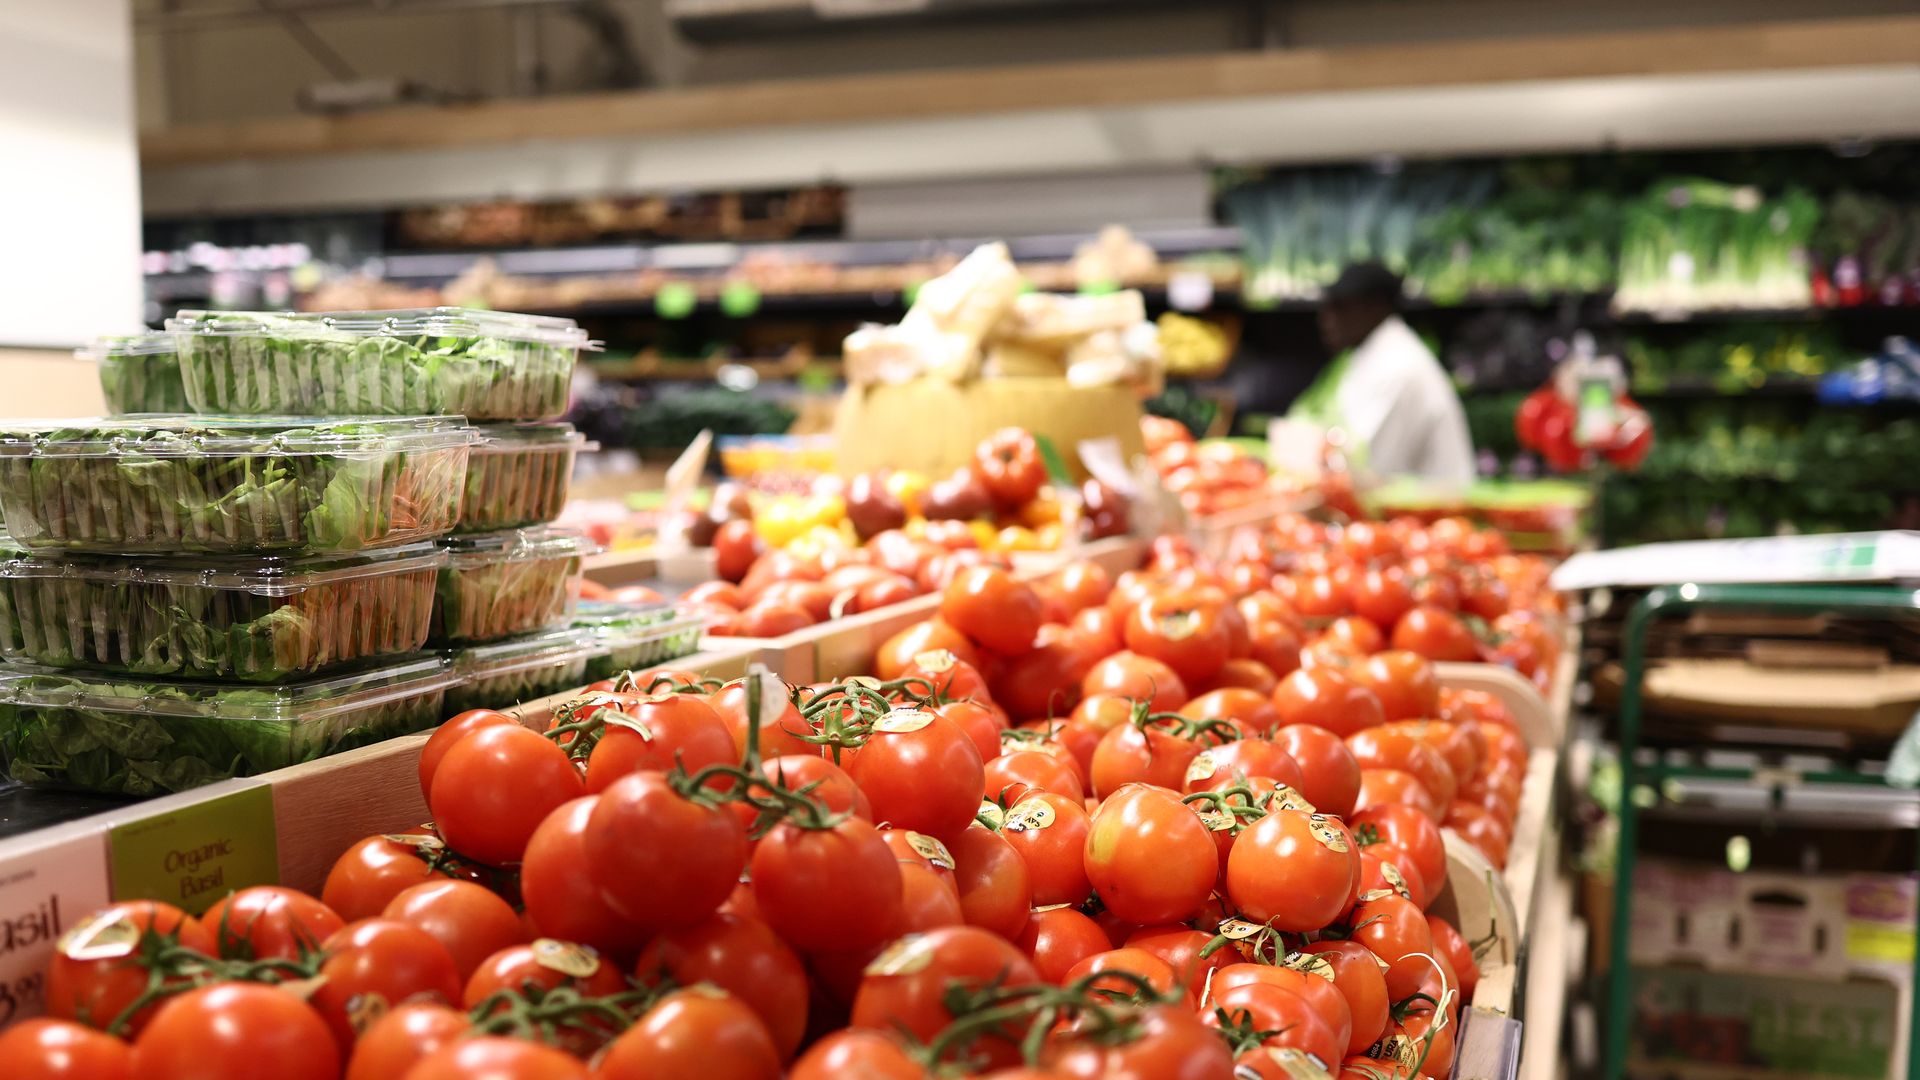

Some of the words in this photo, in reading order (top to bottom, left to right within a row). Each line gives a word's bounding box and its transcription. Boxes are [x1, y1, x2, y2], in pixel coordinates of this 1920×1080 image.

[164, 838, 232, 873] Organic
[180, 866, 223, 899] Basil
[0, 894, 61, 951] asil
[1383, 1039, 1399, 1057] URA
